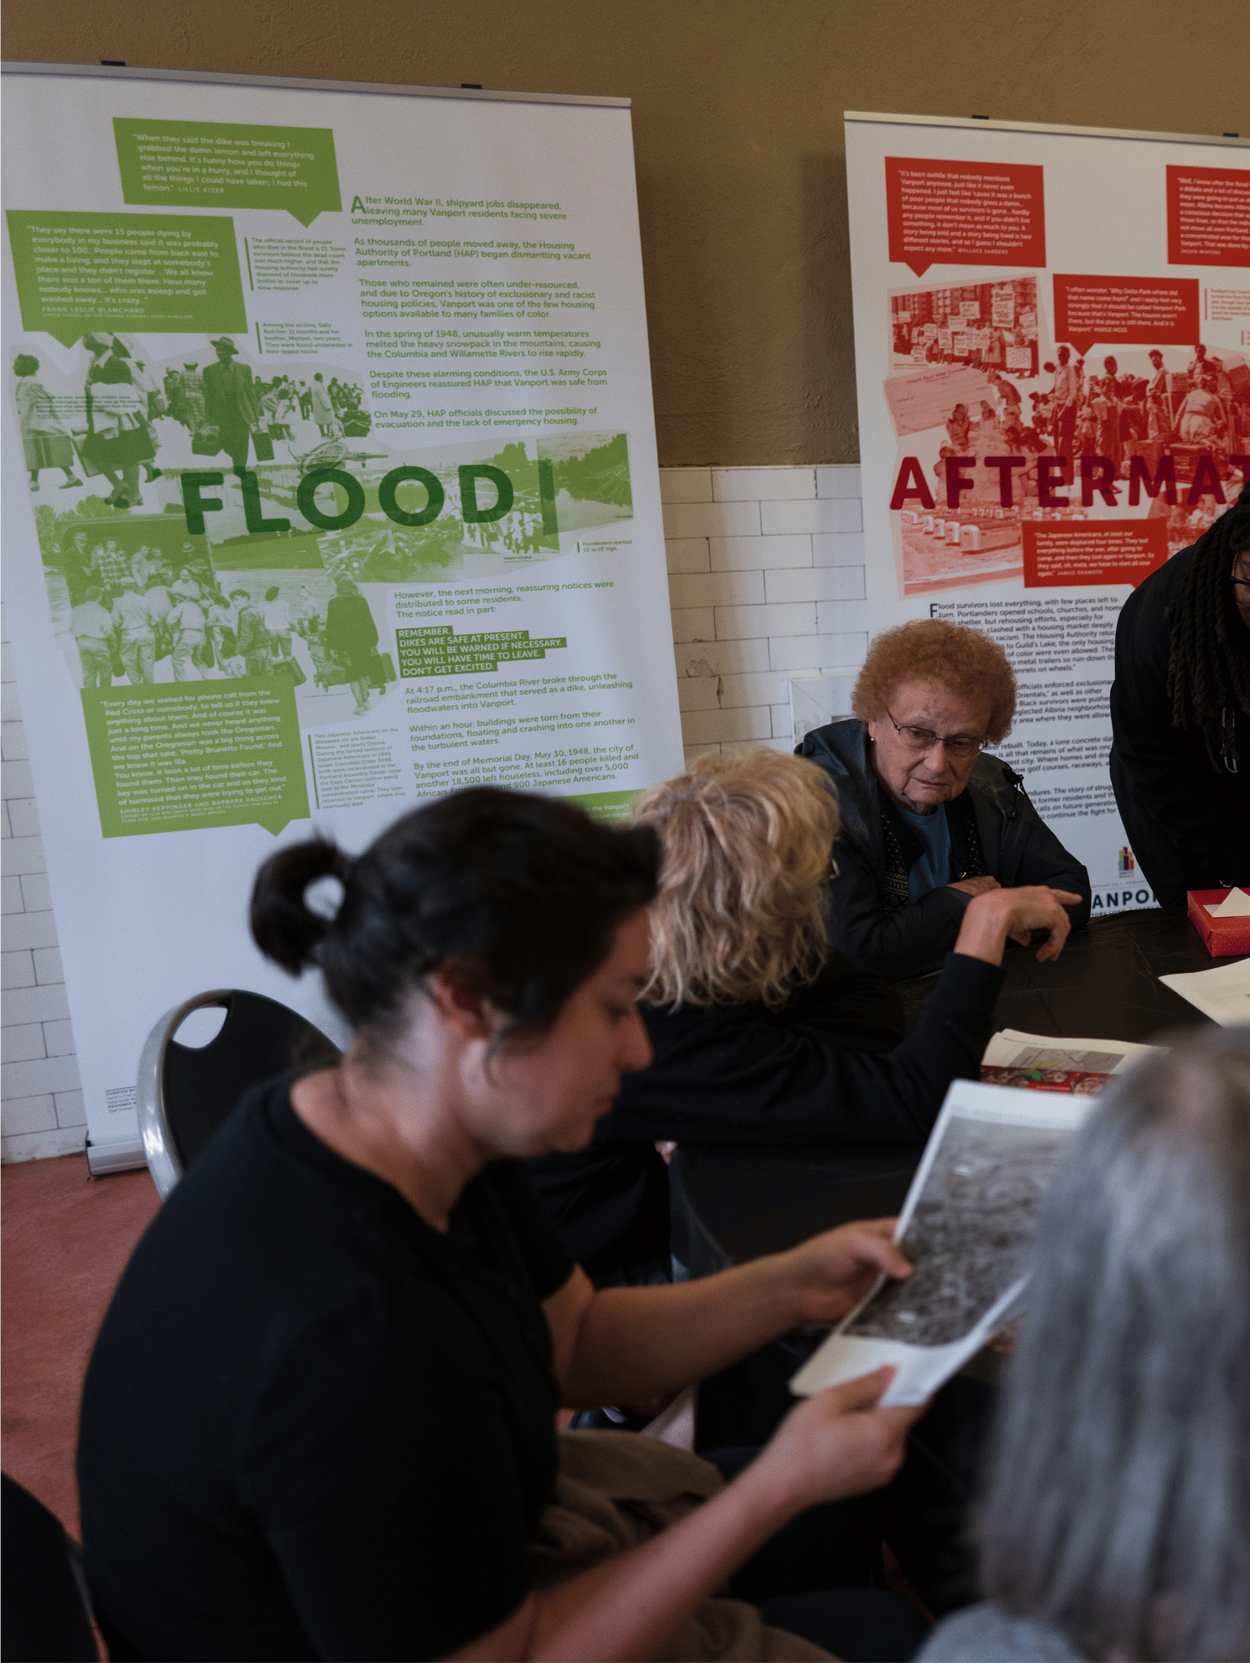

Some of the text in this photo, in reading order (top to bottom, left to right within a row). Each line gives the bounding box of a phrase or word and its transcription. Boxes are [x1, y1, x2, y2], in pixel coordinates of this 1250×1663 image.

[384, 195, 412, 204] World
[414, 196, 432, 205] War
[445, 198, 483, 208] shipyard
[485, 199, 504, 209] jobs
[366, 206, 400, 216] leaving
[402, 209, 427, 217] many
[430, 207, 465, 218] Vanport
[468, 209, 508, 218] residents
[510, 210, 537, 220] facing
[354, 237, 365, 245] As
[367, 237, 415, 246] thousands
[417, 238, 427, 246] of
[429, 238, 460, 248] people
[462, 239, 493, 247] moved
[522, 240, 536, 248] the
[538, 240, 574, 251] Housing
[355, 247, 398, 257] Authority
[400, 248, 410, 256] of
[412, 248, 451, 256] Portland
[453, 248, 478, 258] (HAP)
[480, 249, 508, 259] began
[510, 249, 560, 260] dismantling
[364, 329, 373, 337] In
[376, 329, 390, 337] the
[393, 330, 421, 339] spring
[423, 329, 432, 337] of
[462, 329, 504, 339] unusually
[533, 329, 589, 339] temperatures
[366, 339, 397, 347] melted
[400, 339, 415, 347] the
[417, 339, 443, 349] heavy
[446, 339, 490, 349] snowpack
[502, 339, 517, 347] the
[568, 339, 600, 348] causing
[367, 349, 381, 357] the
[384, 349, 428, 357] Columbia
[430, 349, 447, 357] and
[449, 349, 496, 357] Willamette
[499, 348, 525, 356] Rivers
[374, 409, 387, 417] On
[390, 409, 408, 419] May
[427, 408, 446, 416] HAP
[448, 408, 482, 416] officials
[484, 407, 526, 416] discussed
[528, 407, 542, 415] the
[544, 406, 586, 417] possibility
[588, 406, 596, 414] of
[375, 420, 424, 428] evacuation
[426, 418, 443, 427] and
[445, 418, 460, 426] the
[462, 418, 479, 426] lack
[482, 417, 491, 426] of
[493, 419, 541, 427] emergency
[180, 464, 515, 535] FLOOD
[438, 588, 452, 596] the
[454, 587, 473, 595] next
[516, 583, 559, 592] reassuring
[561, 581, 592, 589] notices
[395, 598, 442, 608] distributed
[1044, 597, 1058, 605] with
[1074, 596, 1096, 606] places
[1097, 595, 1108, 603] left
[396, 609, 413, 618] The
[415, 609, 442, 617] notice
[445, 606, 464, 615] read
[476, 605, 496, 615] part:
[399, 638, 425, 647] DIKES
[427, 637, 445, 645] ARE
[447, 635, 468, 644] SAFE
[470, 635, 481, 643] AT
[400, 648, 420, 656] YOU
[422, 646, 444, 655] WILL
[446, 645, 457, 653] BE
[459, 643, 499, 652] WARNED
[501, 642, 508, 650] IF
[401, 658, 421, 666] YOU
[423, 656, 445, 664] WILL
[447, 654, 471, 663] HAVE
[473, 652, 494, 661] TIME
[497, 651, 510, 659] TO
[402, 666, 431, 675] DON'T
[434, 665, 451, 673] GET
[1027, 763, 1040, 774] golf
[1046, 806, 1117, 819] continue the fight for
